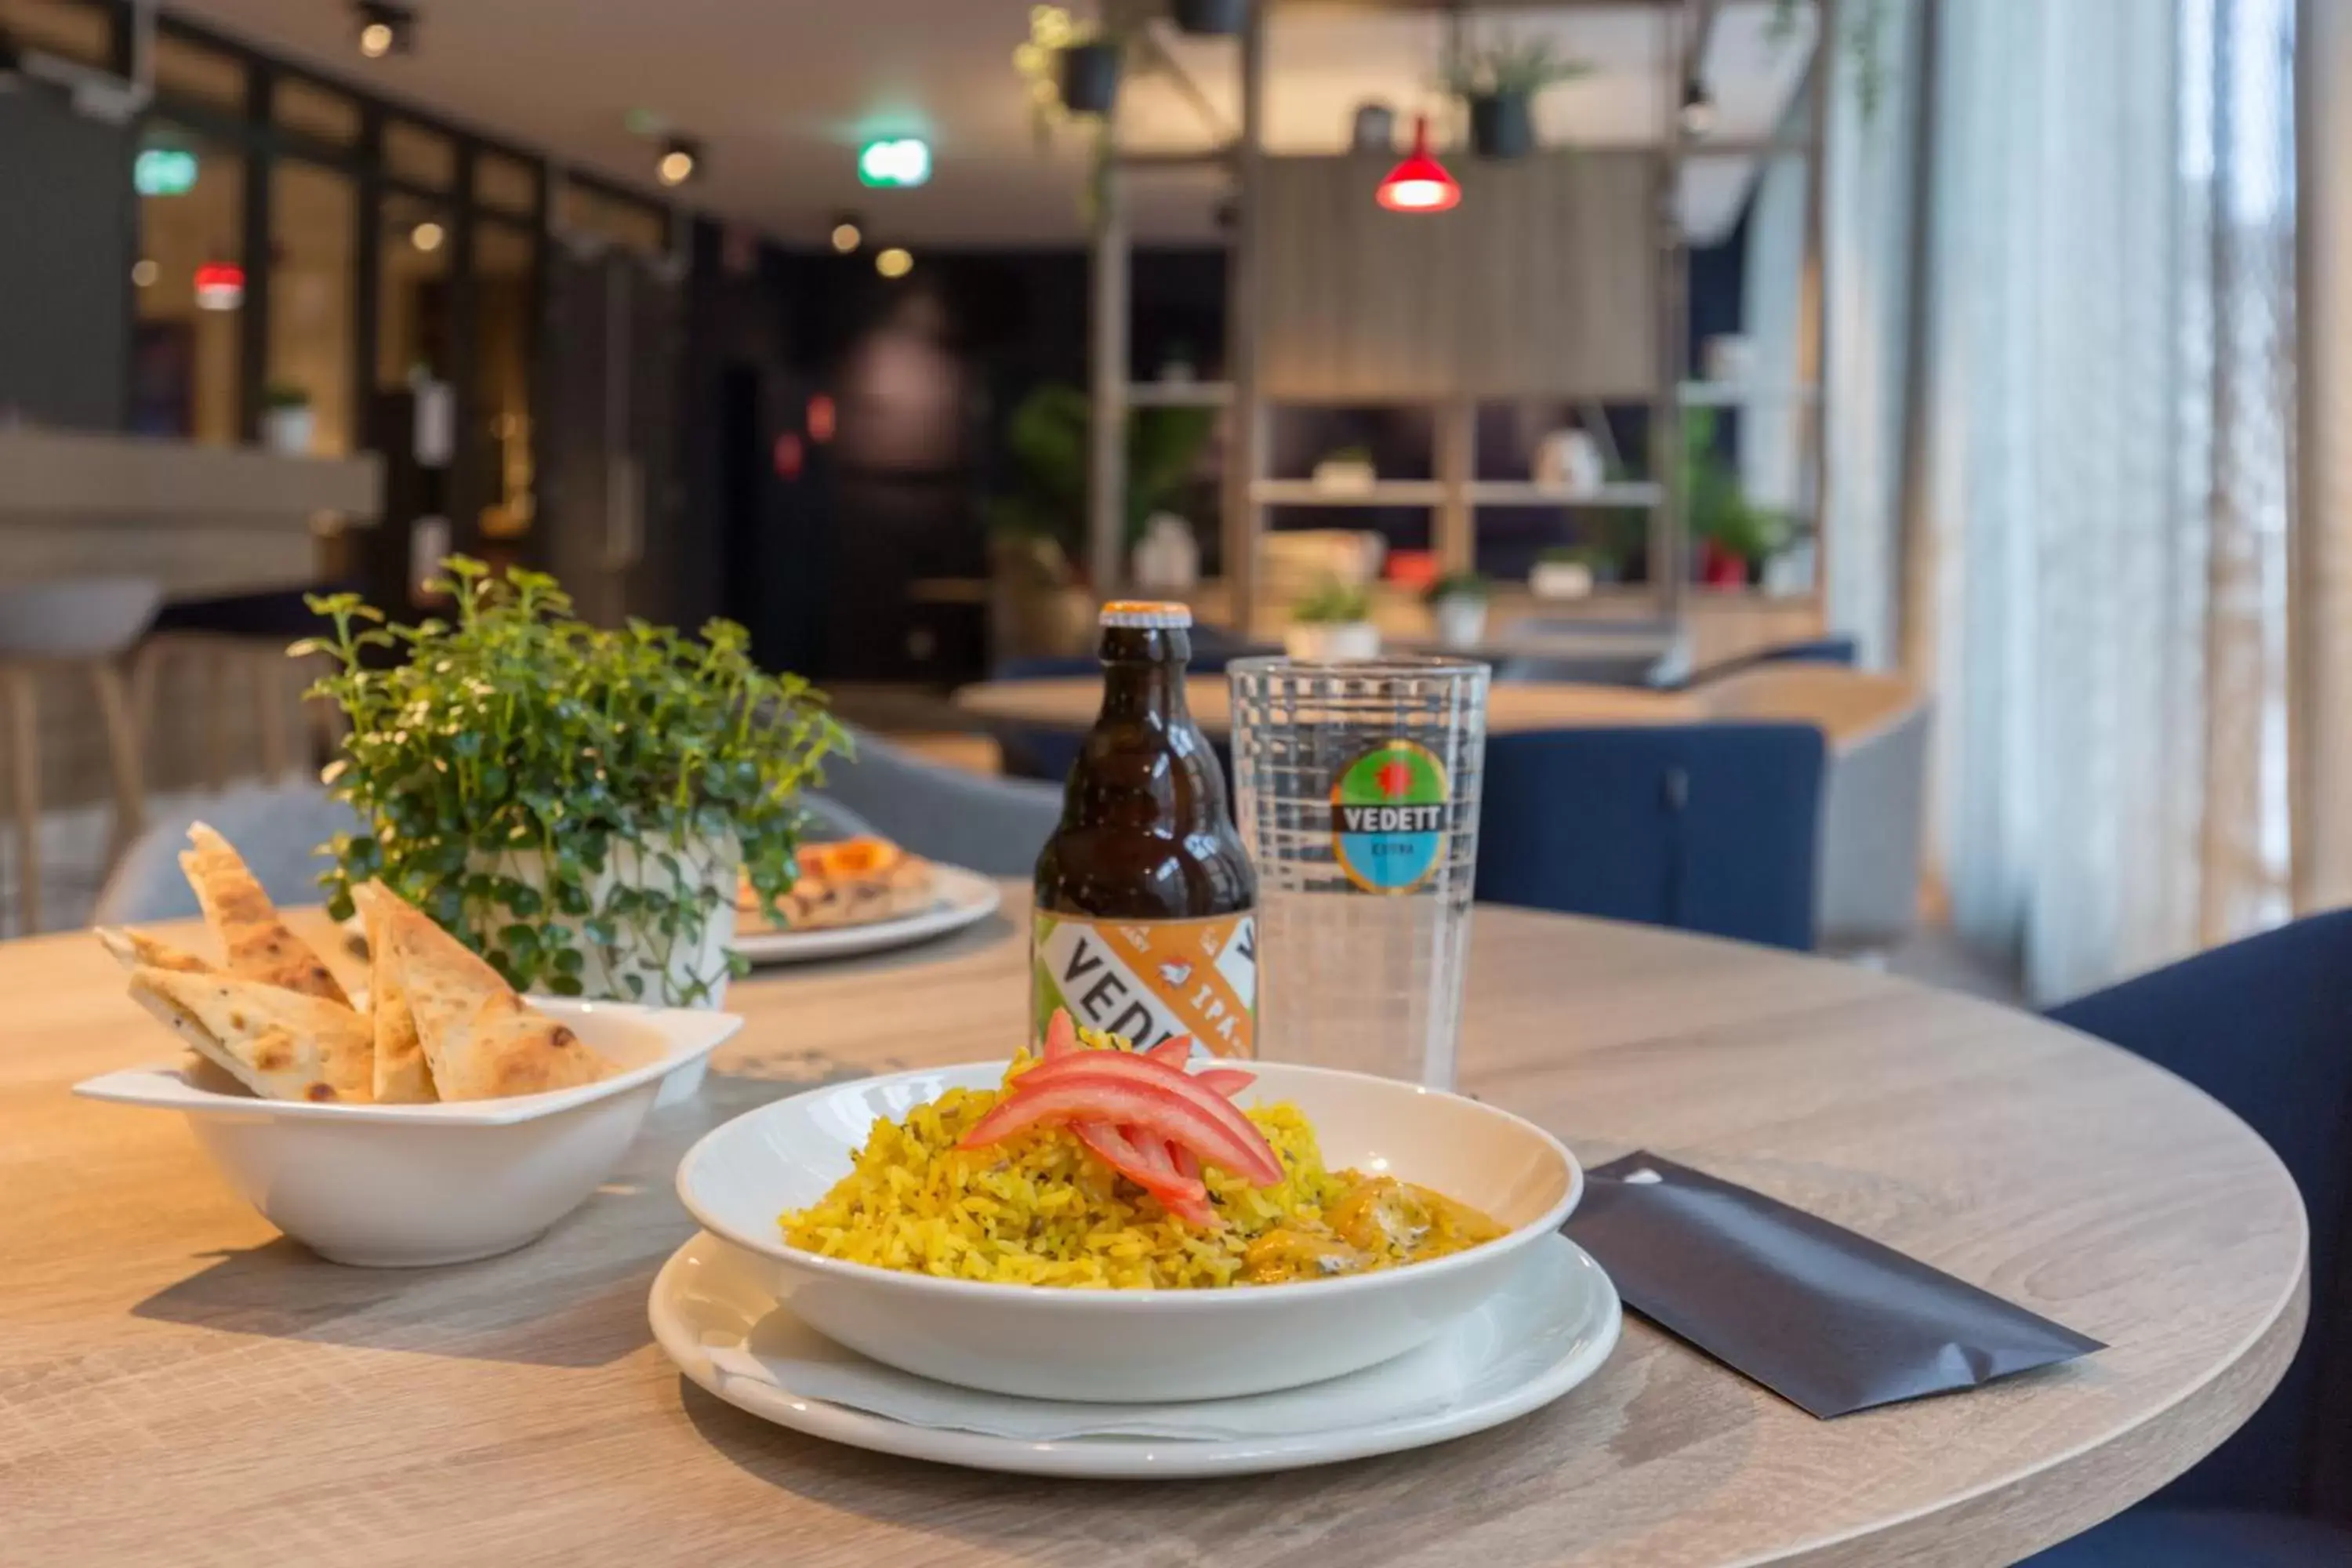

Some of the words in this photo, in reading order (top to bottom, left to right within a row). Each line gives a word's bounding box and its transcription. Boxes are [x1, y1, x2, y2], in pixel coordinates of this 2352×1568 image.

[1343, 806, 1441, 831] VEDETT
[1063, 935, 1174, 1051] VED
[1190, 983, 1236, 1041] IPA
